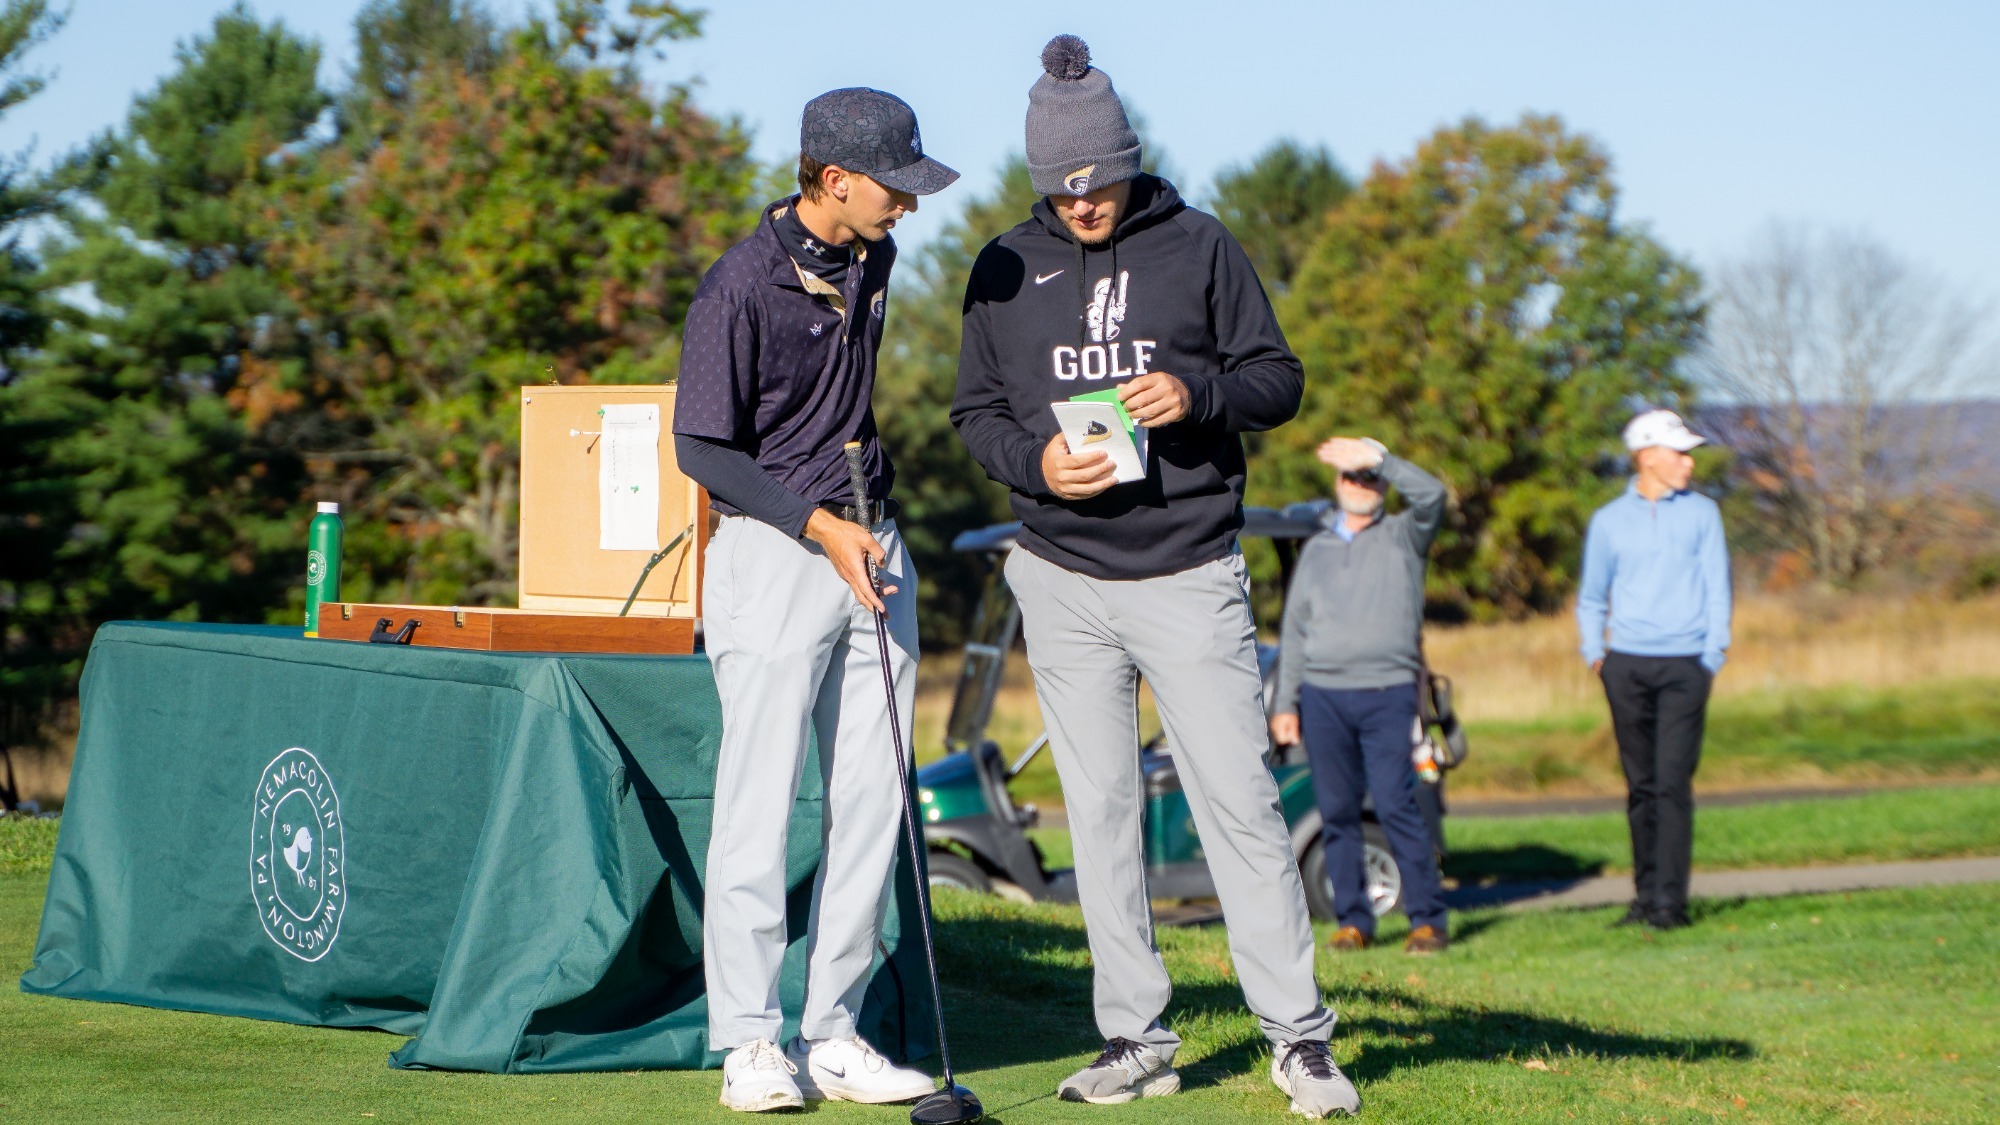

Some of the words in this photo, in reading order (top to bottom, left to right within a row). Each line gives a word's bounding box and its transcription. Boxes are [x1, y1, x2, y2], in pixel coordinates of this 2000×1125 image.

[1053, 341, 1156, 381] GOLF
[259, 761, 336, 829] NEMACOLIN
[282, 823, 291, 836] 19
[256, 854, 268, 885] PA
[308, 876, 317, 891] 87
